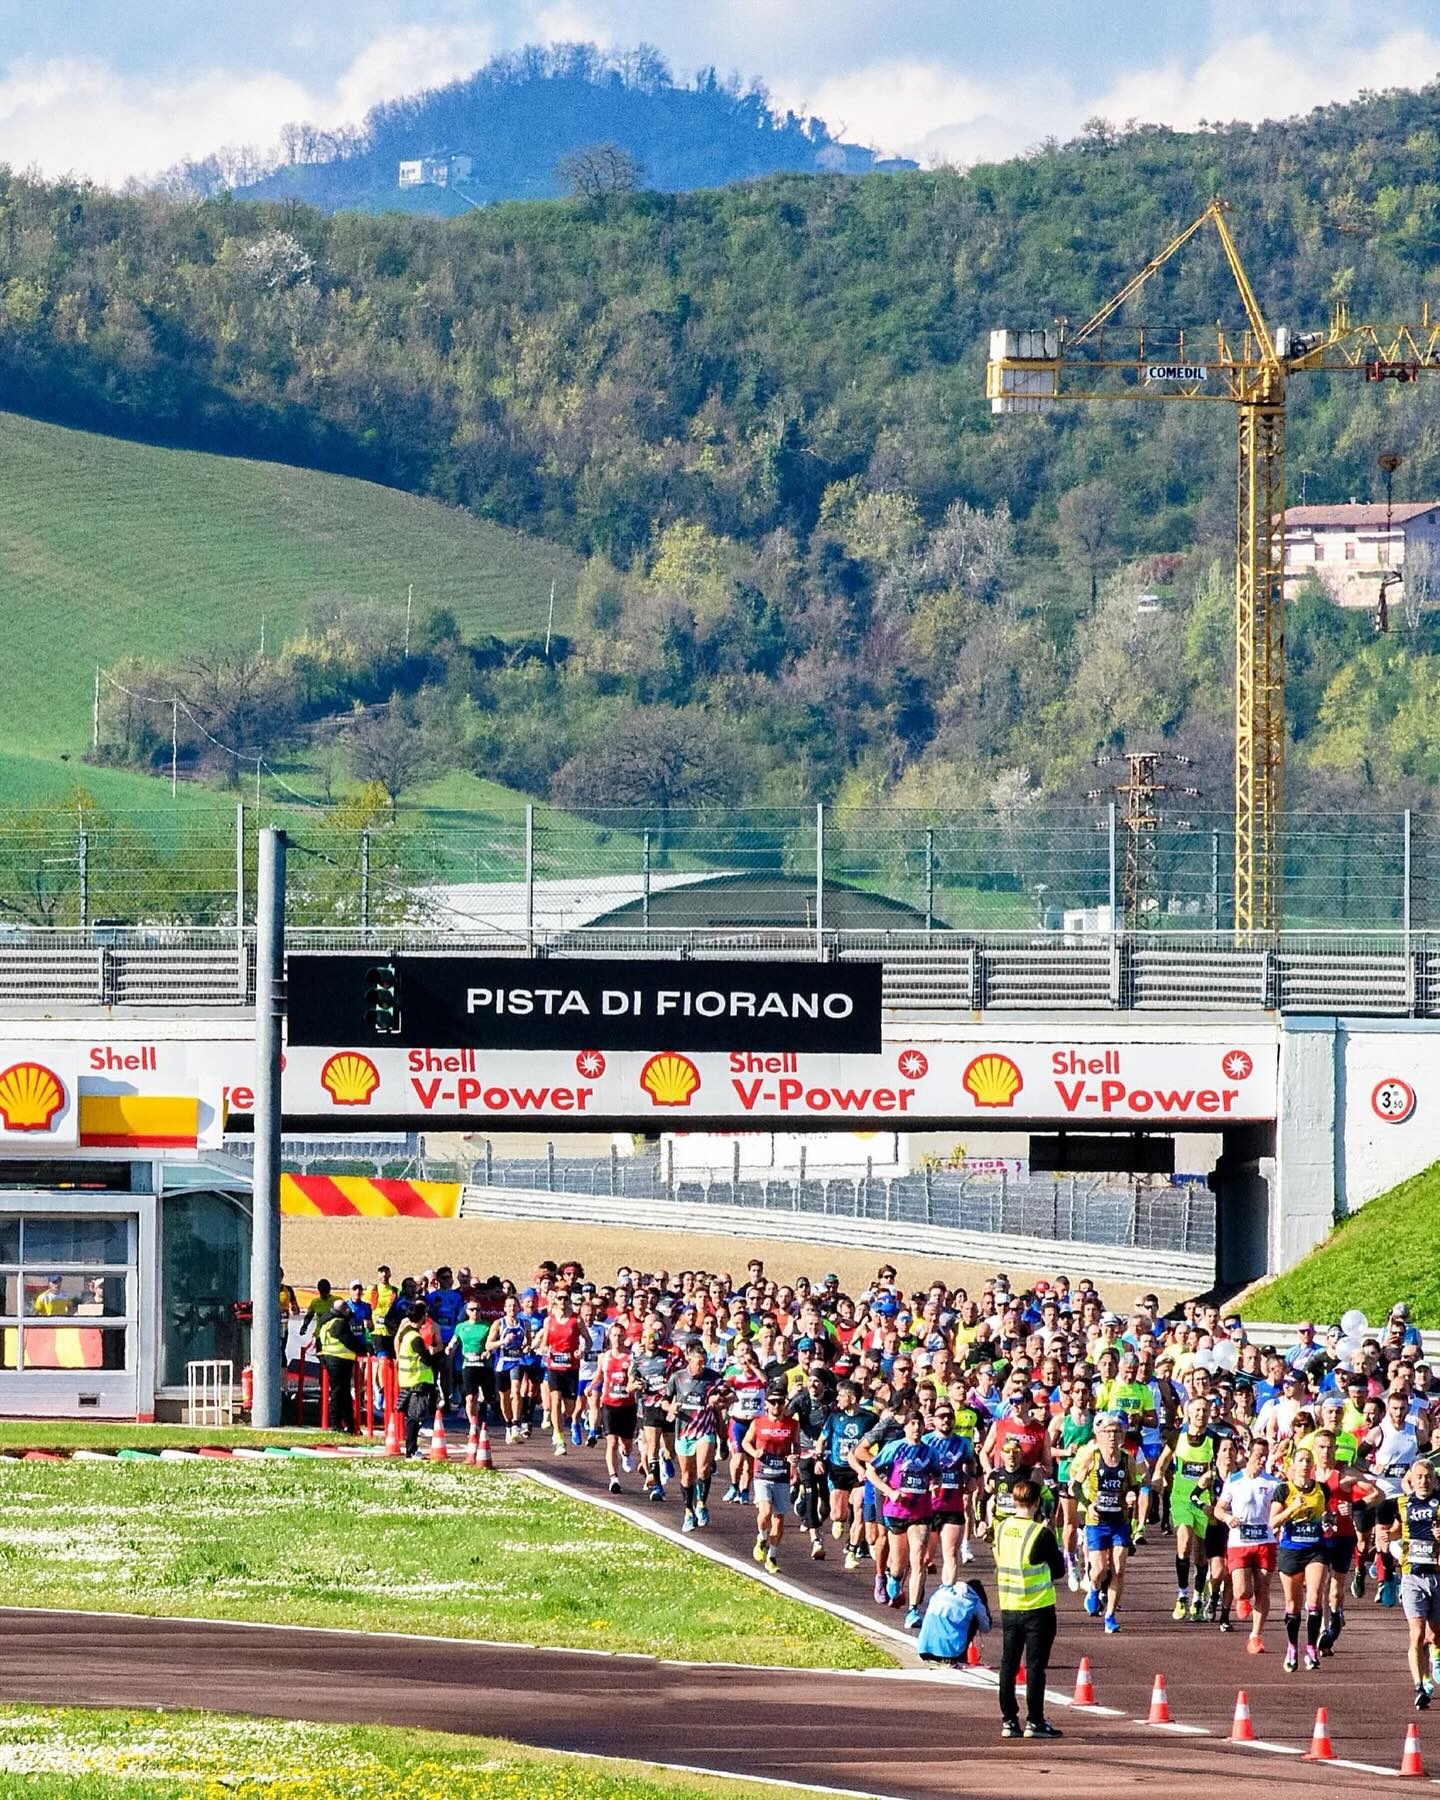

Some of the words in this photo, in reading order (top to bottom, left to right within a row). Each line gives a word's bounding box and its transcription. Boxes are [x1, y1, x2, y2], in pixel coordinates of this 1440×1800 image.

[1149, 366, 1204, 380] COMEDIL
[467, 988, 590, 1015] PISTA
[602, 990, 641, 1016] DI
[657, 991, 853, 1019] FIORANO
[89, 1046, 157, 1071] Shell
[408, 1048, 476, 1073] Shell
[729, 1051, 798, 1073] Shell
[1052, 1050, 1120, 1075] Shell
[411, 1078, 593, 1111] V-Power
[732, 1079, 916, 1112] V-Power
[1054, 1080, 1239, 1113] V-Power
